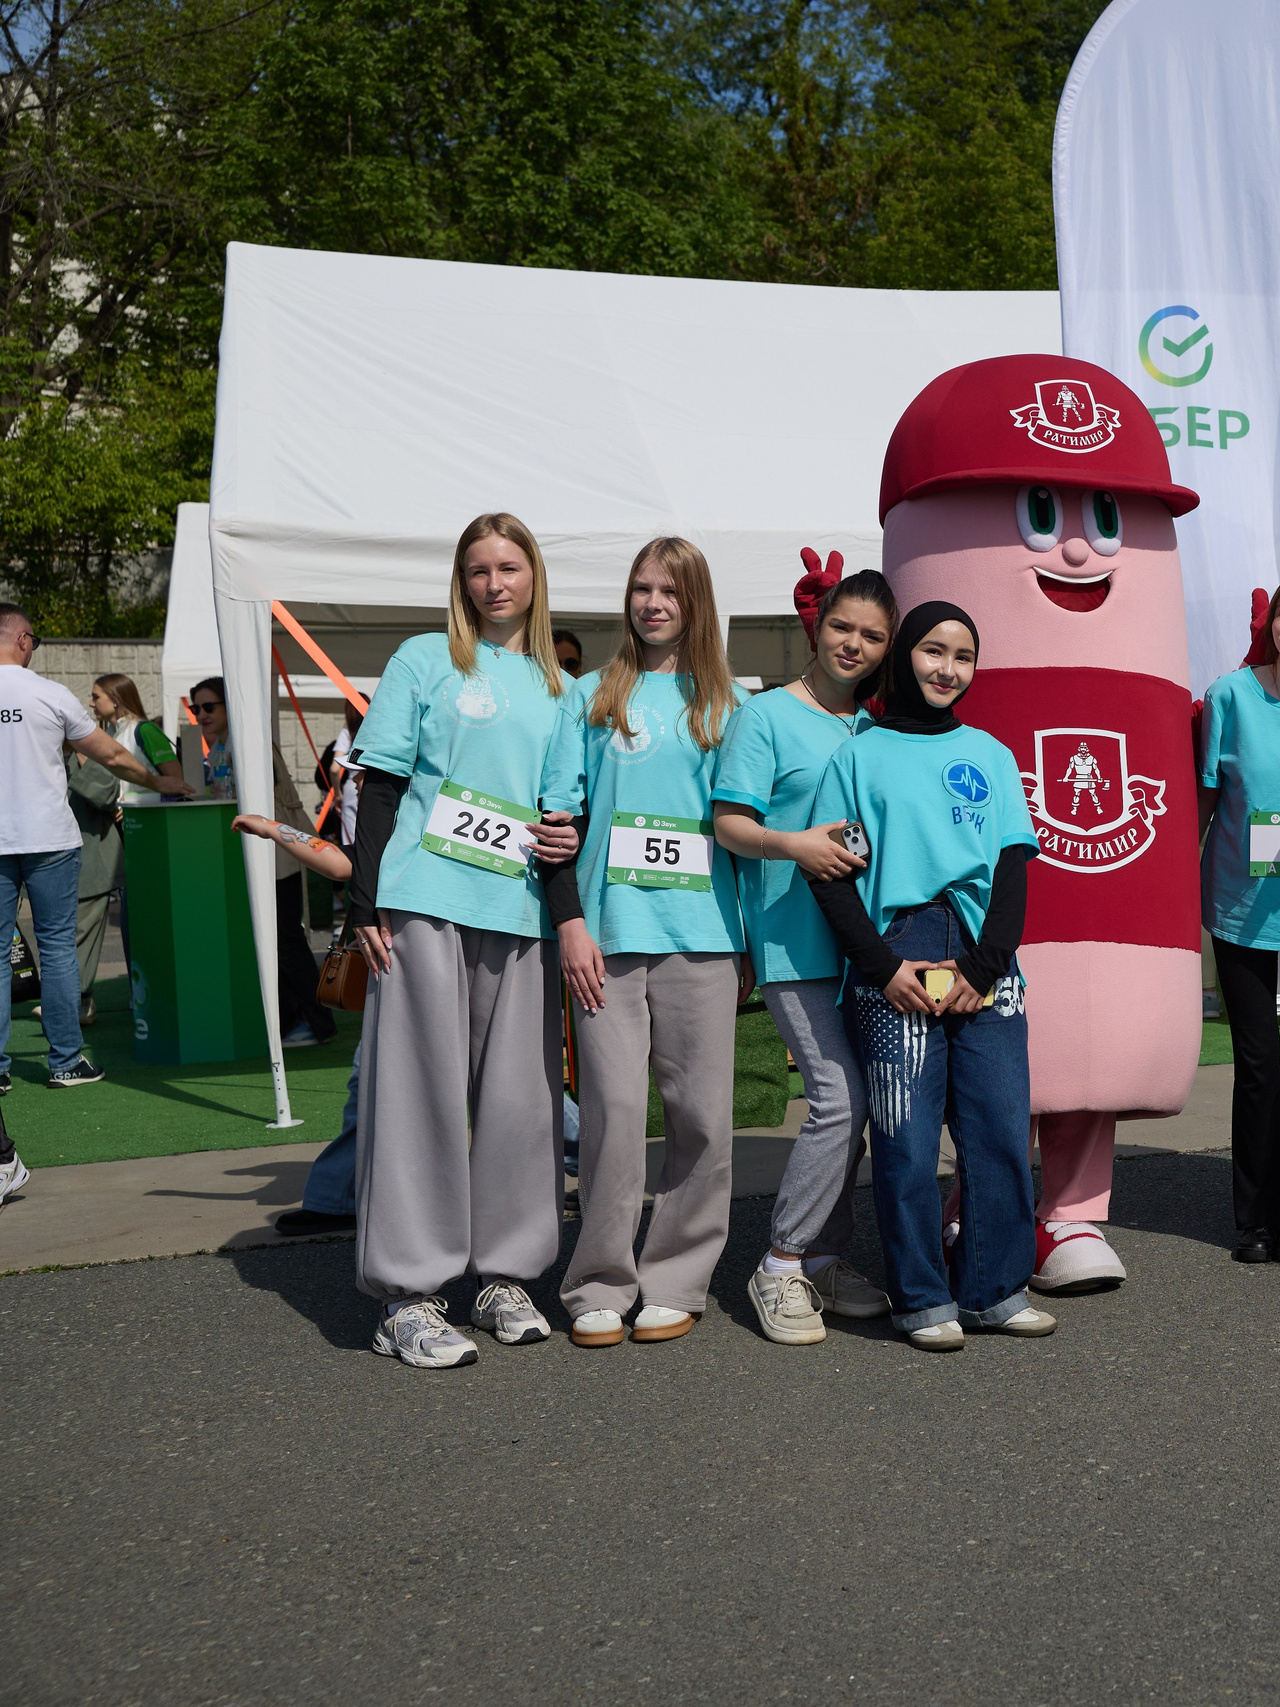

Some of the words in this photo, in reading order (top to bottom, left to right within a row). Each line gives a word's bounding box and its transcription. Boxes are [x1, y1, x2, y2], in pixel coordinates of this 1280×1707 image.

[1043, 429, 1104, 446] РАТИМИР
[1146, 406, 1250, 450] БЕР
[0, 708, 23, 723] 85
[452, 811, 511, 851] 262
[1036, 827, 1138, 860] РАТИМИР
[644, 837, 681, 865] 55
